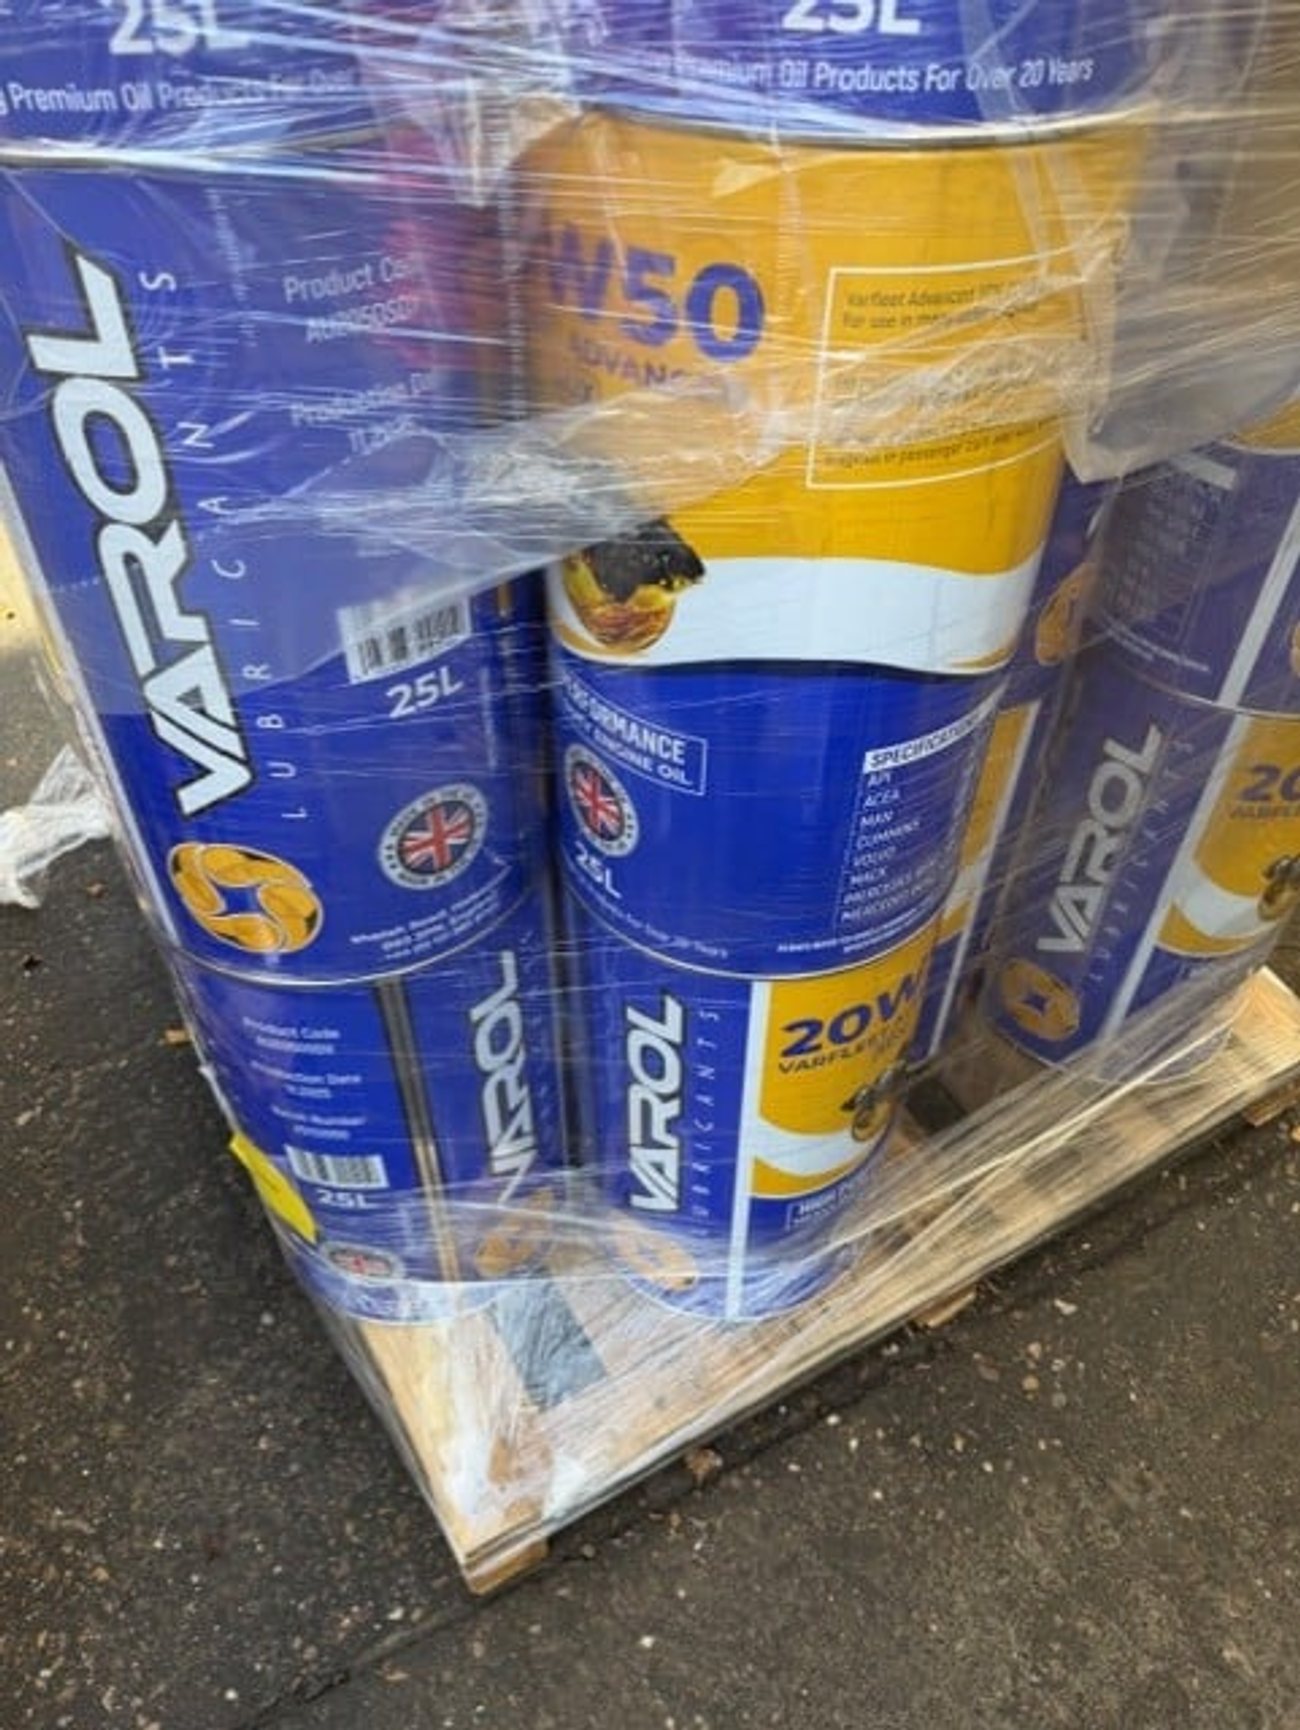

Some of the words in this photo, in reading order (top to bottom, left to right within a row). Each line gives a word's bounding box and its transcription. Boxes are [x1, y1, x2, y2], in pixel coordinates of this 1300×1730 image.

[8, 81, 118, 112] Premium
[120, 81, 153, 110] Oil
[779, 60, 807, 88] Oil
[814, 62, 919, 93] Products
[924, 64, 961, 92] For
[966, 61, 1015, 92] Over
[1018, 60, 1046, 89] 20
[1048, 57, 1095, 84] Years
[282, 262, 374, 303] Product
[22, 245, 254, 820] VAROL
[139, 268, 308, 822] LUBRICANTS
[384, 664, 465, 718] 25L
[869, 710, 983, 770] SPECIFICATION
[1034, 722, 1163, 953] VAROL
[573, 840, 622, 899] 25L
[468, 948, 538, 1208] VAROL
[625, 993, 685, 1213] VAROL
